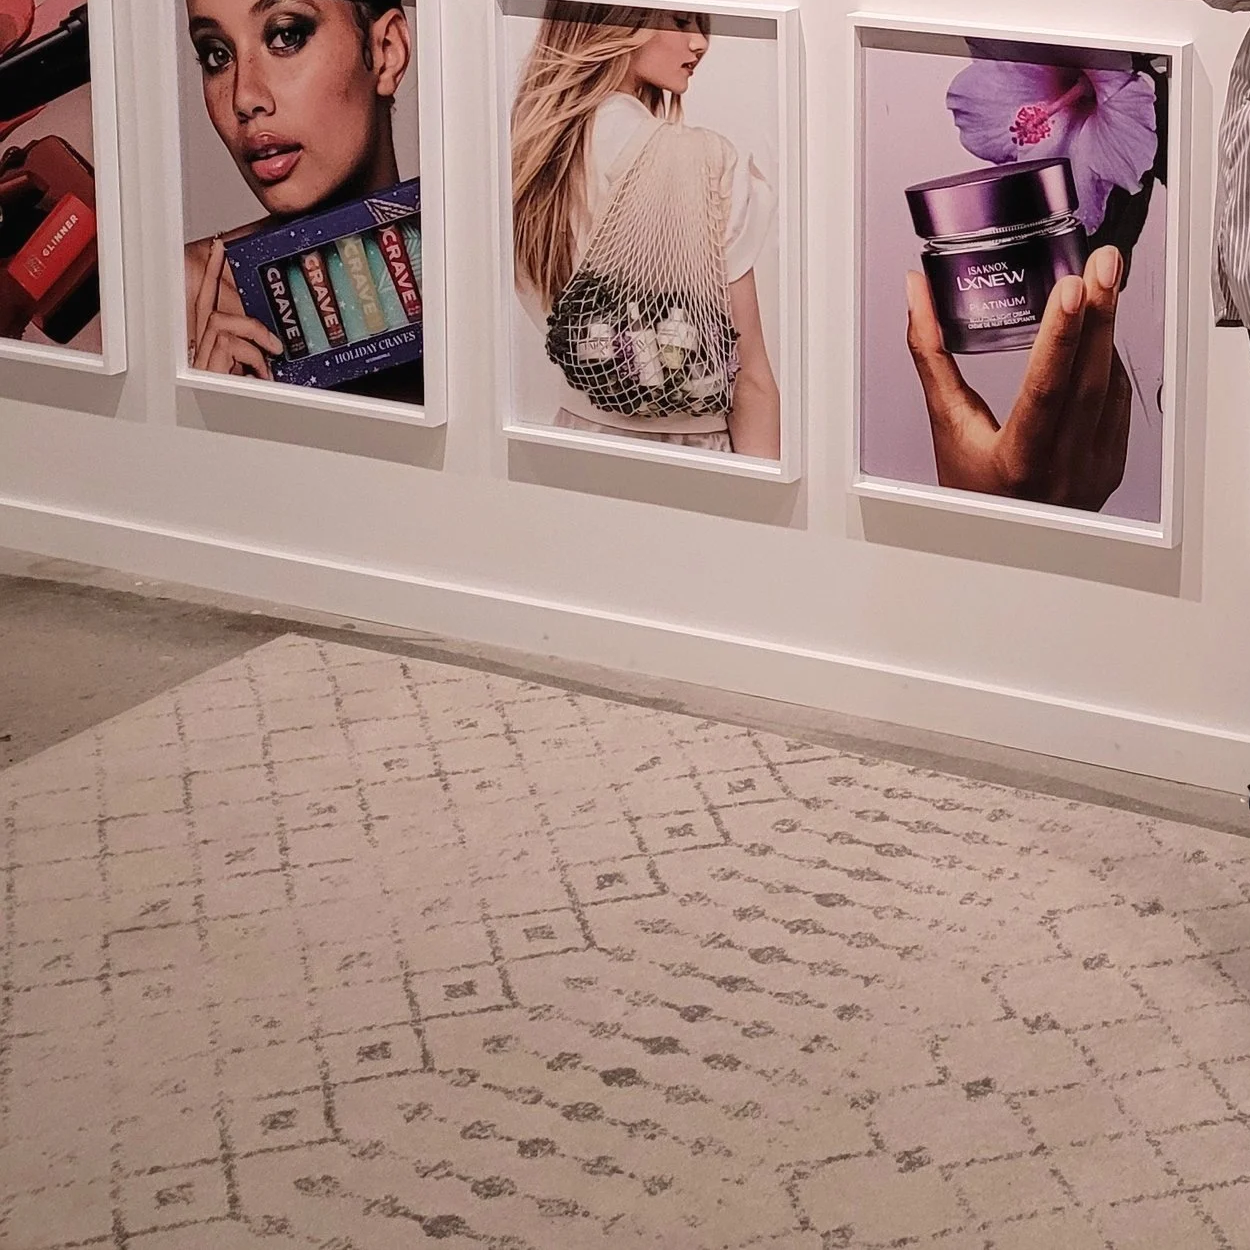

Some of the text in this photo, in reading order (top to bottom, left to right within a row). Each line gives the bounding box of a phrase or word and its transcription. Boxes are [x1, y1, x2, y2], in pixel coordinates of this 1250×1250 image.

[304, 255, 339, 323] CRAVE
[343, 243, 377, 316] CRAVE
[381, 229, 417, 304] CRAVE
[956, 268, 1025, 291] LXNEW
[967, 261, 1008, 276] ISA KNOX
[266, 267, 300, 340] CRAVE
[1012, 310, 1031, 318] CREAM
[334, 343, 378, 364] HOLIDAY
[378, 331, 416, 350] CRAVES
